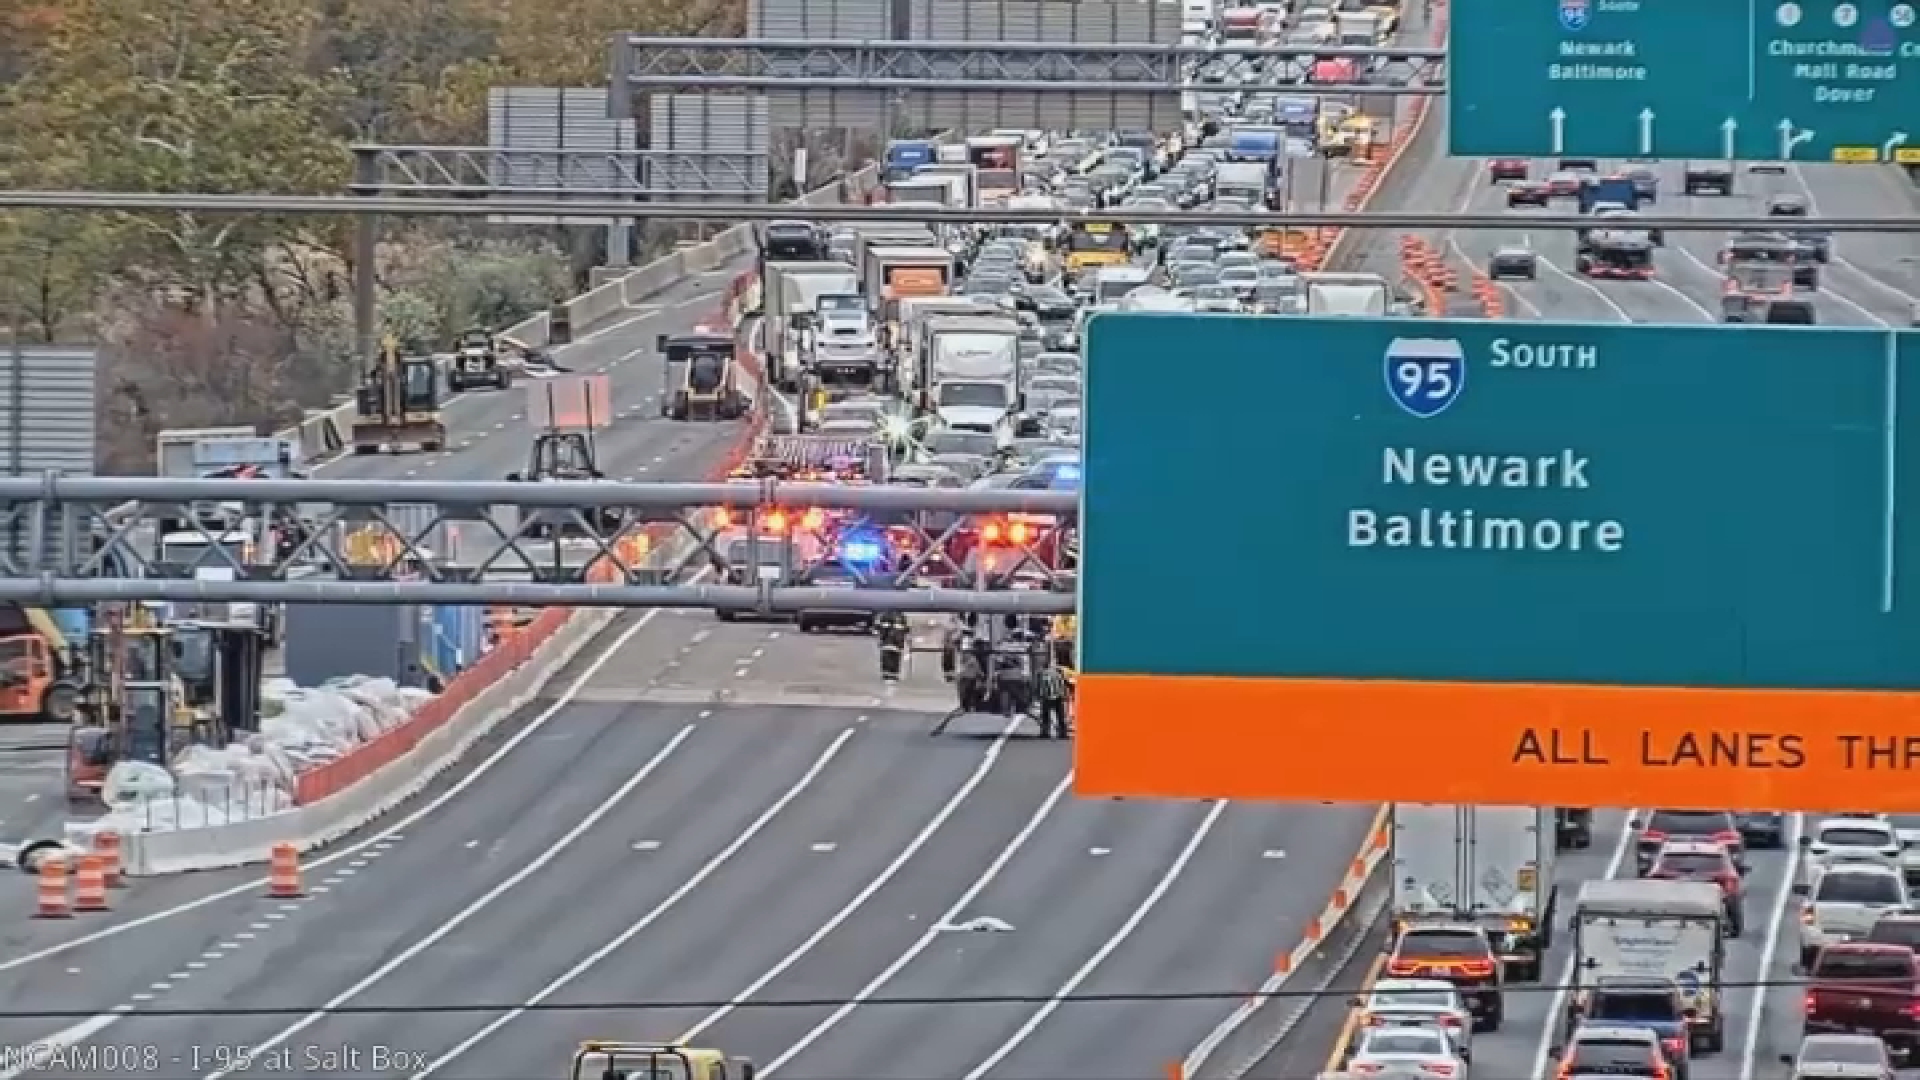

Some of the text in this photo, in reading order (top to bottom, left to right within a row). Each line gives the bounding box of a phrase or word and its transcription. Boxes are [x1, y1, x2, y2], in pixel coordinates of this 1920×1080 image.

[1560, 40, 1635, 56] Newark
[1768, 39, 1892, 57] Churchm
[1549, 63, 1646, 80] Baltimore
[1794, 62, 1896, 79] Mall Road
[1814, 85, 1875, 102] Dover
[1490, 337, 1598, 369] SOUTH
[1397, 361, 1452, 399] 95
[1382, 447, 1590, 489] Newark
[1347, 508, 1625, 552] Baltimore
[1512, 728, 1609, 766] ALL
[1642, 730, 1807, 769] LANES
